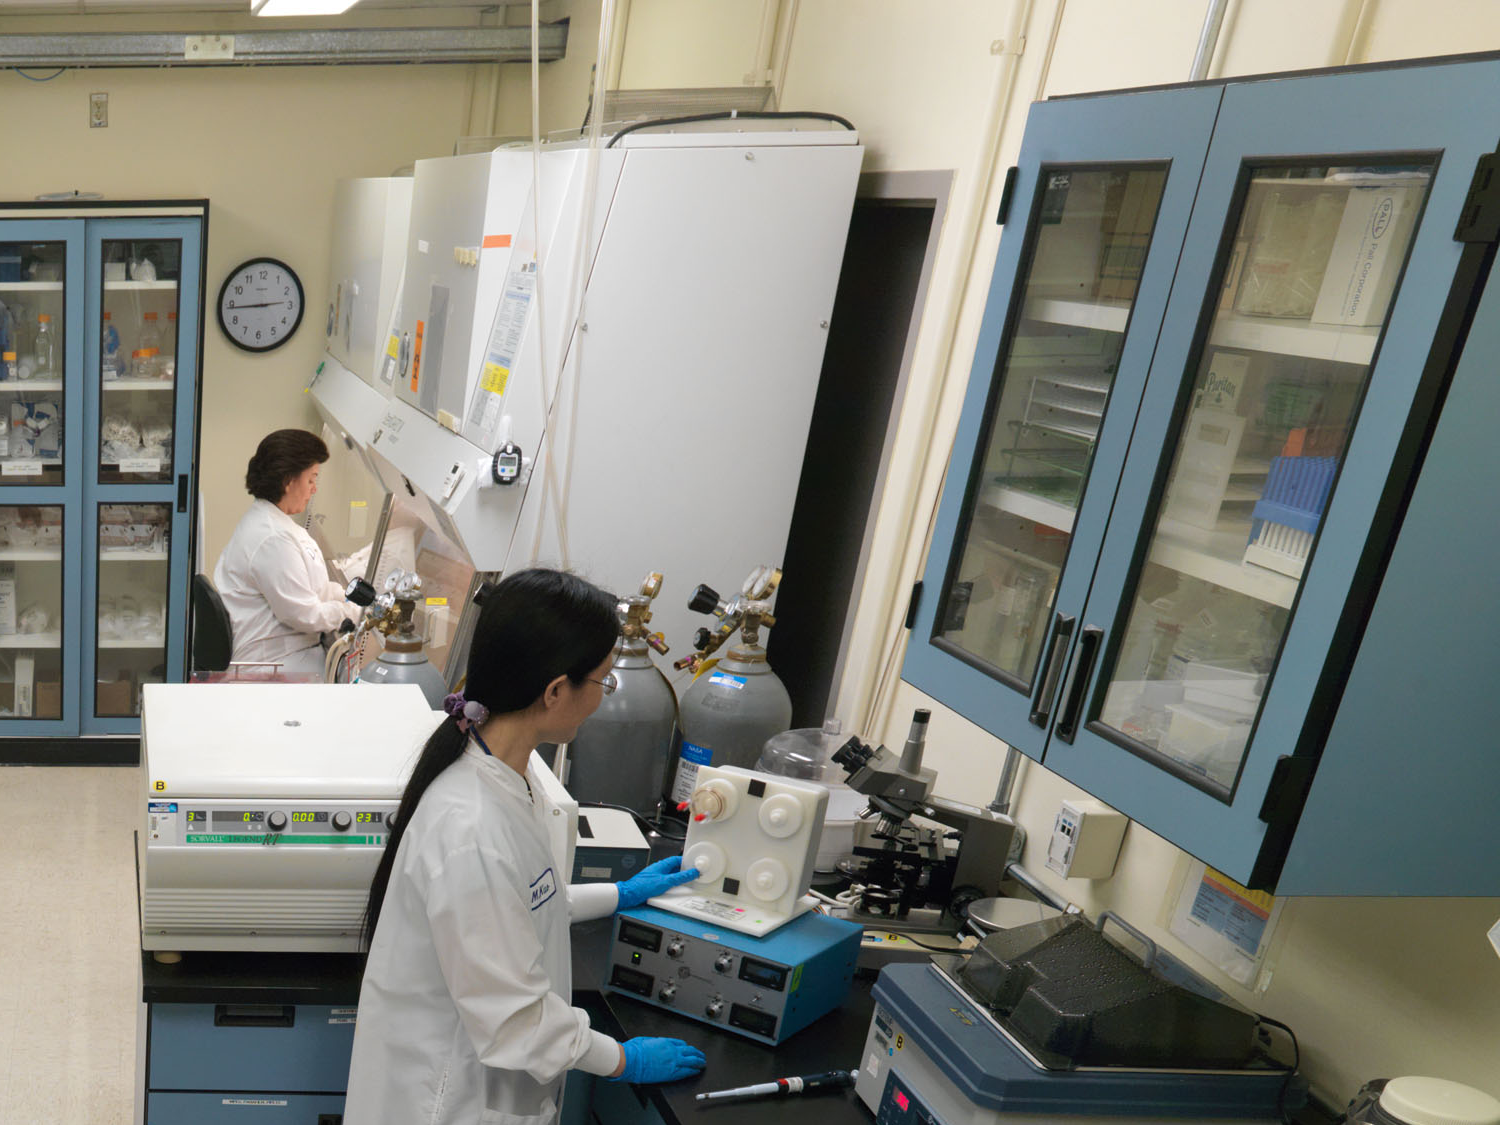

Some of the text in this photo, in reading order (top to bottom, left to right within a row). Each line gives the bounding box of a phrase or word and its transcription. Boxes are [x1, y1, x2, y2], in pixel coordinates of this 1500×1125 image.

[1374, 203, 1390, 233] PALL
[1367, 243, 1378, 260] Pall
[245, 274, 252, 284] 11
[259, 270, 268, 280] 12
[276, 274, 280, 284] 1
[235, 286, 243, 295] 10
[284, 286, 290, 296] 2
[1350, 262, 1372, 317] Corporation
[229, 300, 234, 310] 9
[287, 301, 293, 310] 3
[232, 315, 238, 325] 8
[281, 316, 286, 325] 4
[242, 326, 248, 335] 7
[256, 330, 261, 340] 6
[270, 326, 276, 336] 5
[1207, 372, 1236, 398] Puritan
[156, 782, 164, 790] B
[188, 812, 194, 822] 3
[356, 812, 372, 822] 23
[228, 835, 263, 843] LEGEND
[262, 832, 283, 846] RT
[896, 1035, 904, 1049] B
